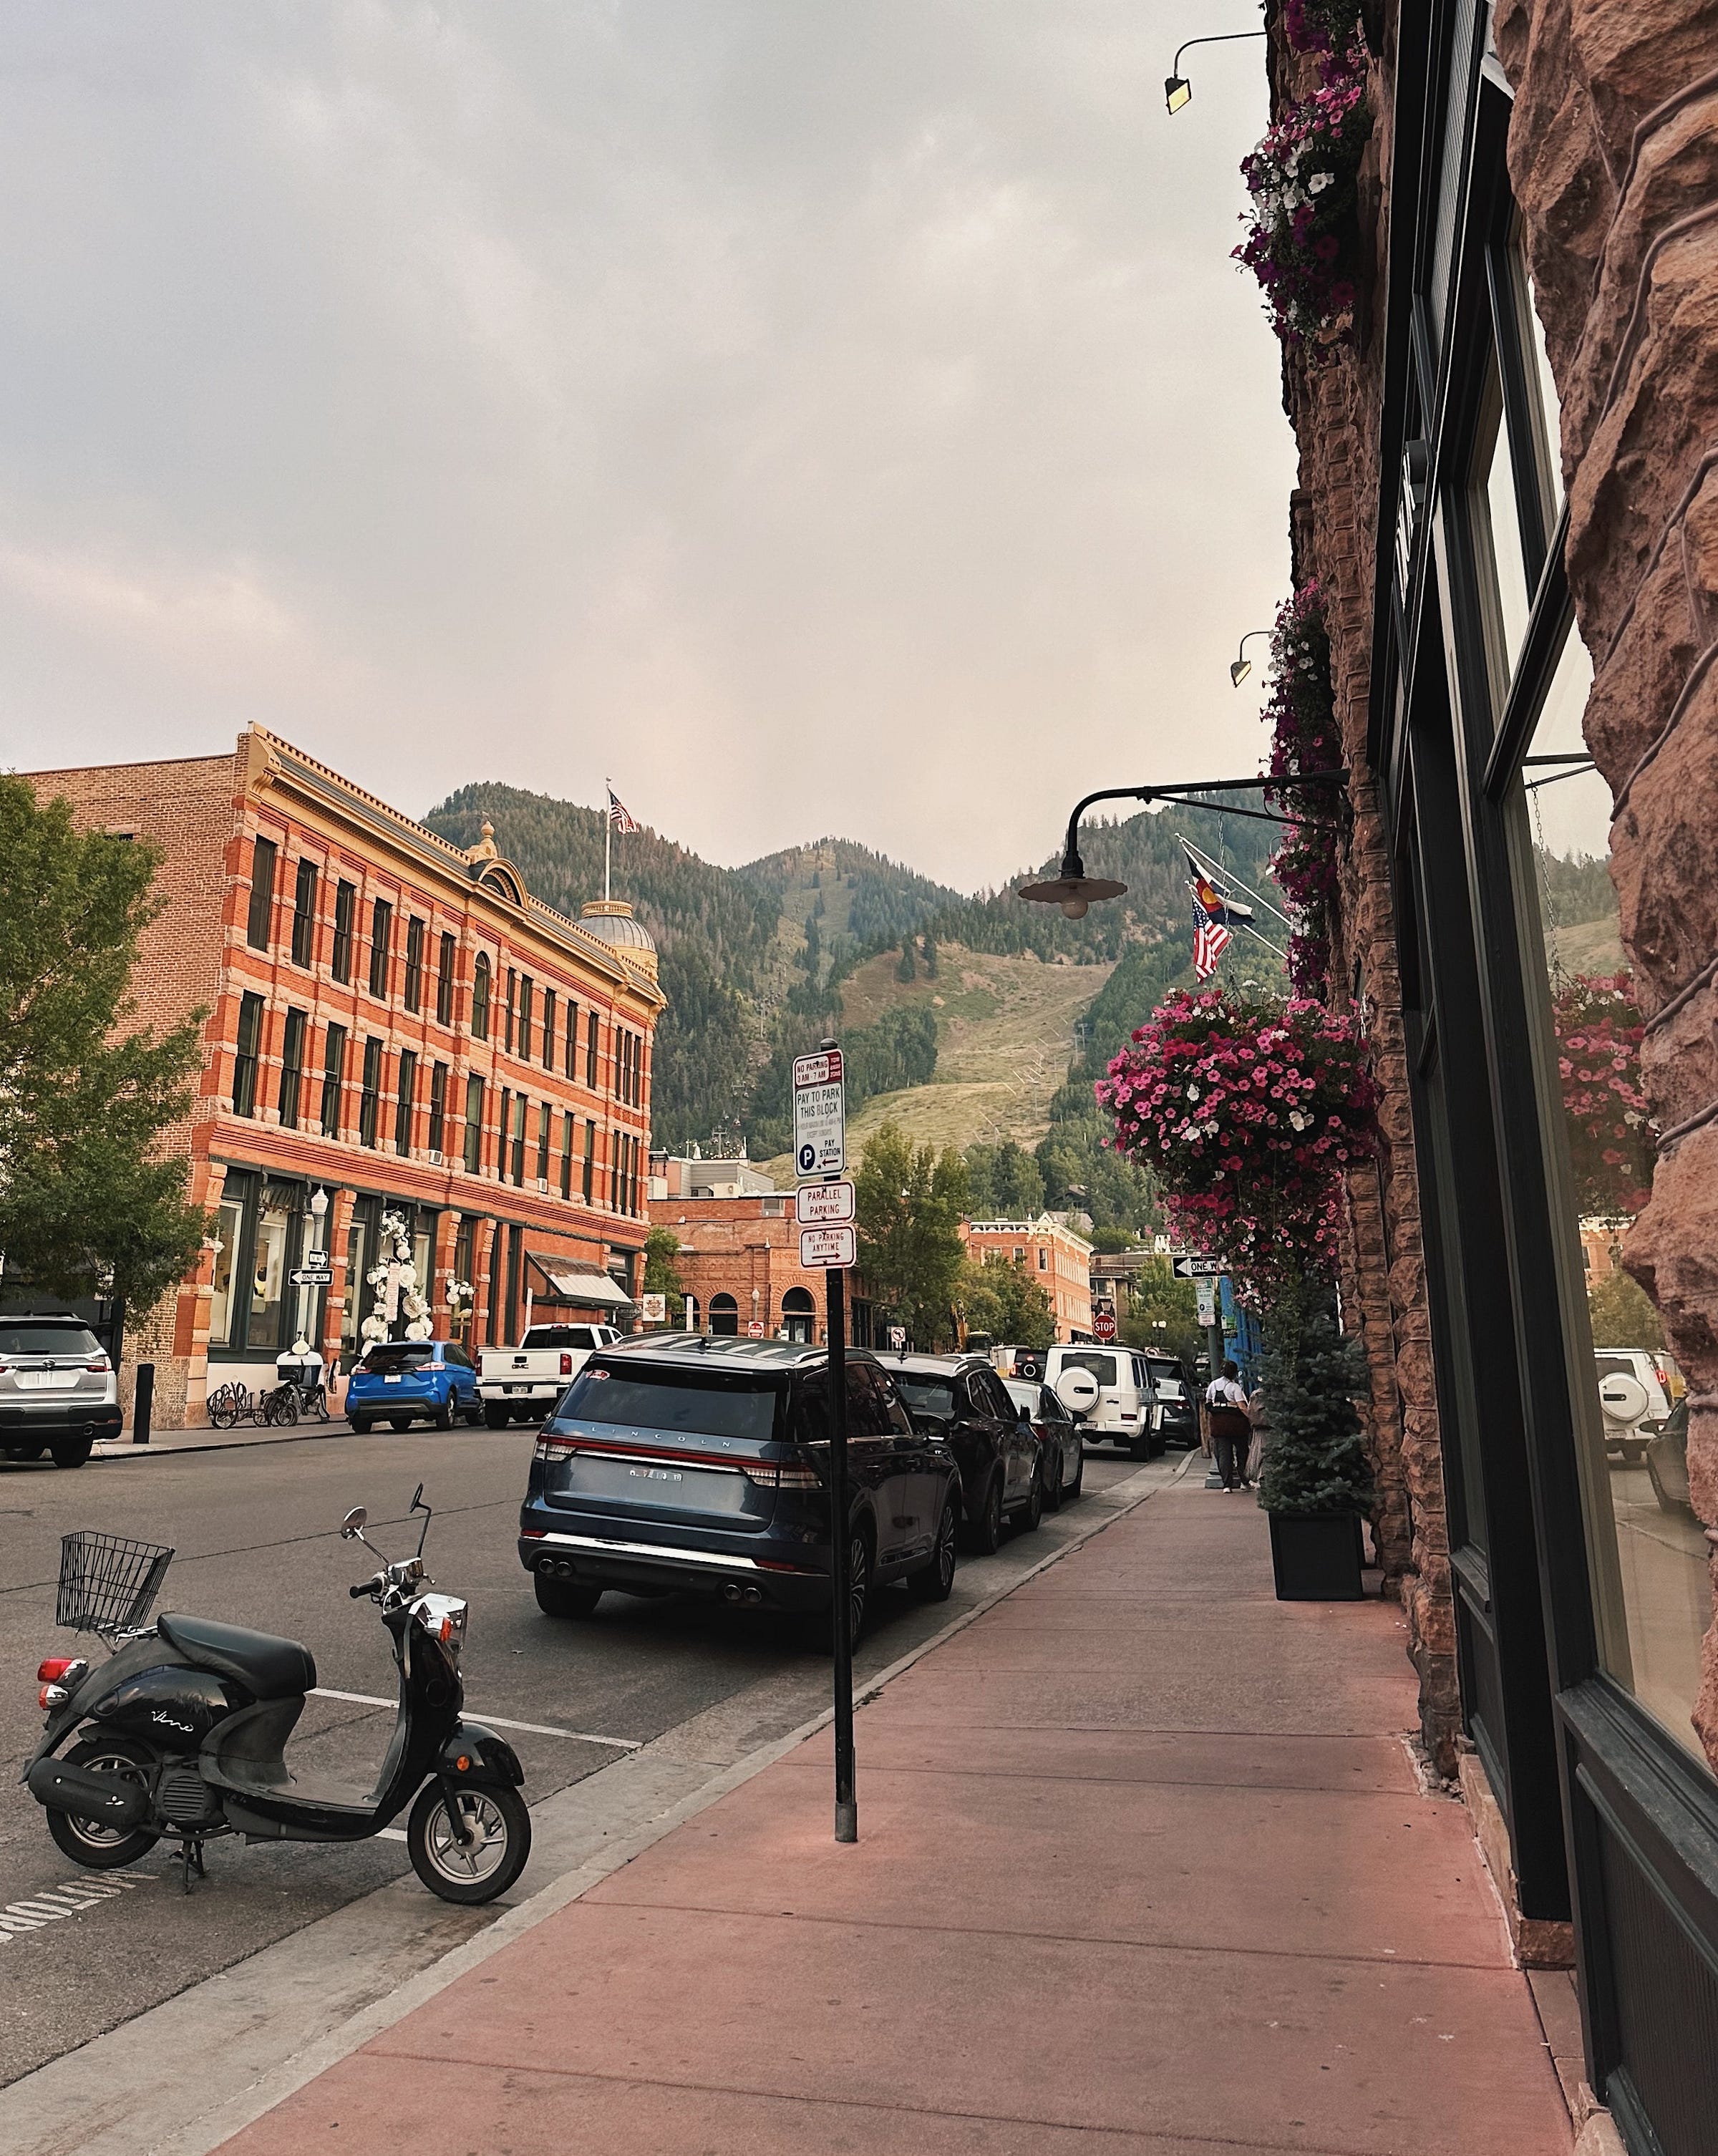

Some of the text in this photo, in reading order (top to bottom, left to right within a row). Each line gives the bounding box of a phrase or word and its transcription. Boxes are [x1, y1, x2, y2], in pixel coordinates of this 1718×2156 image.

[797, 1064, 805, 1073] NO
[807, 1060, 828, 1071] PARKING
[797, 1087, 840, 1105] PAY TO PARK
[801, 1102, 838, 1119] THIS BLOCK
[825, 1139, 835, 1147] PAY
[804, 1149, 812, 1166] P
[820, 1147, 841, 1157] STATION
[807, 1189, 842, 1202] PARALLEL
[810, 1204, 840, 1216] PARKING
[819, 1232, 845, 1242] PARKING
[812, 1242, 840, 1252] ANYTIME
[1190, 1263, 1208, 1271] ONE
[1095, 1322, 1115, 1331] STOP
[591, 1427, 731, 1448] LINCOLN
